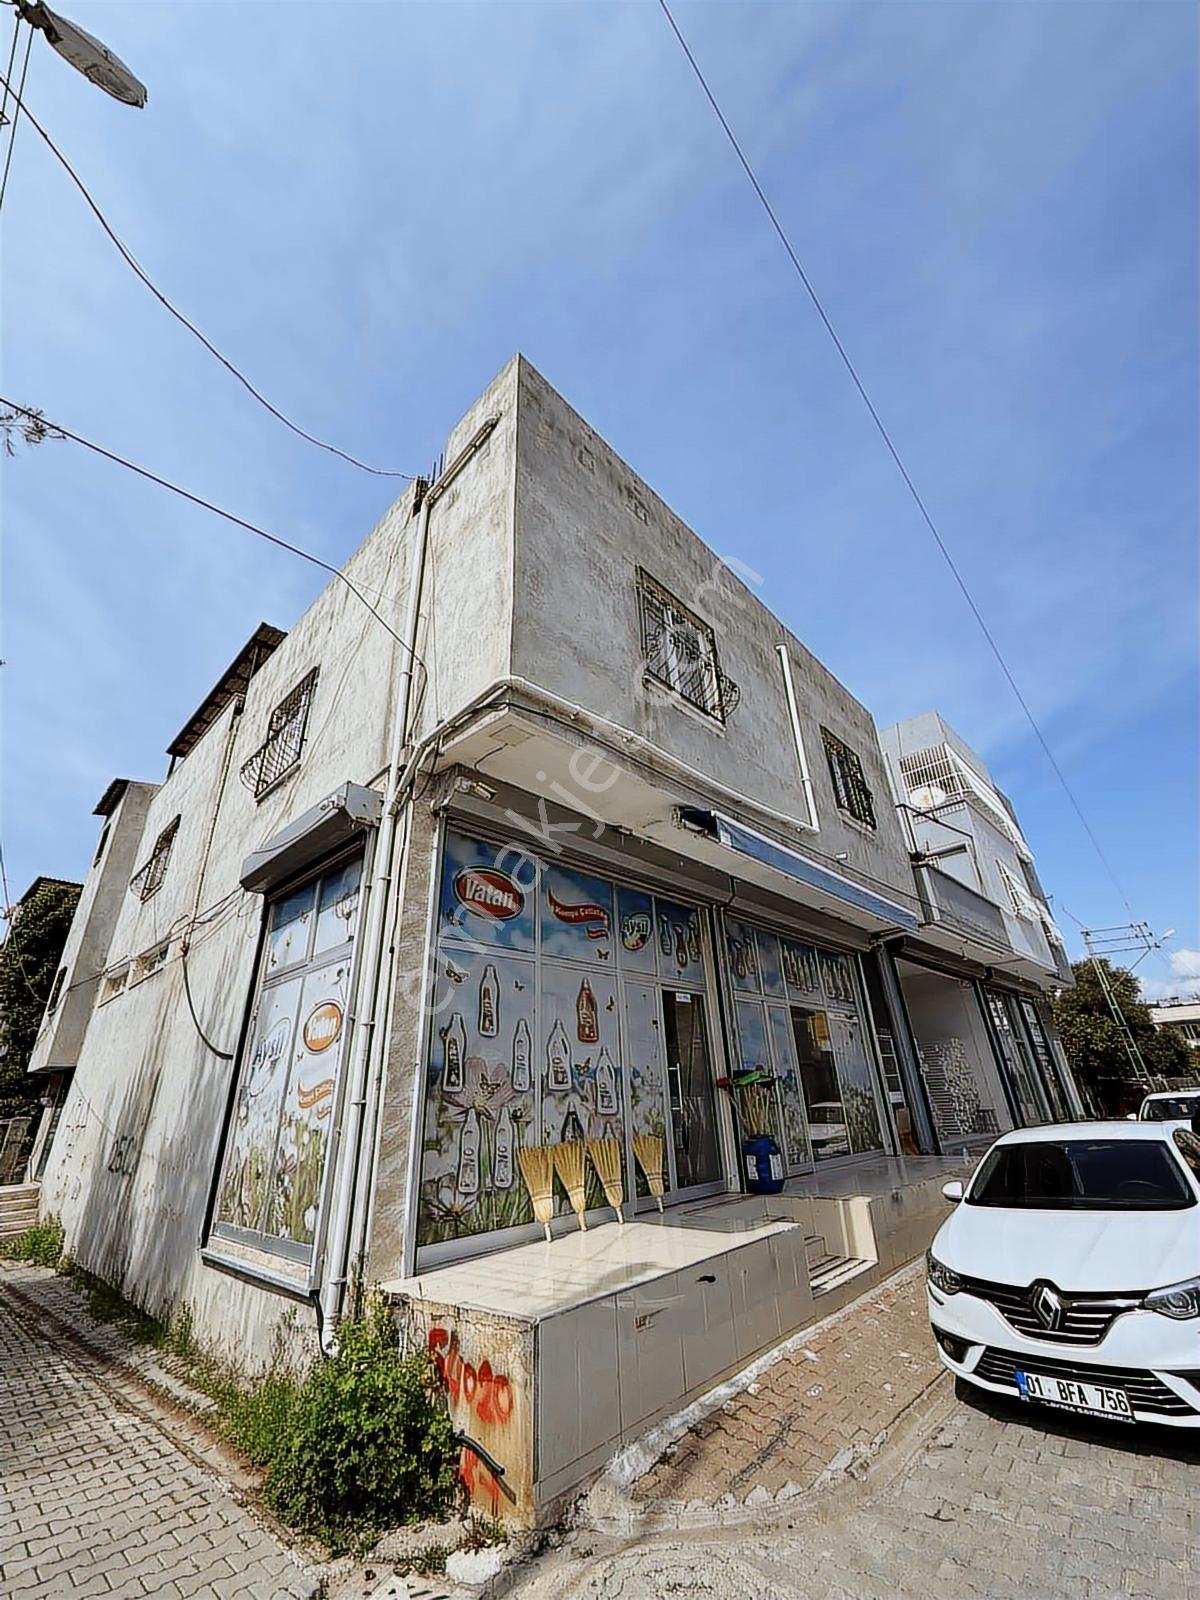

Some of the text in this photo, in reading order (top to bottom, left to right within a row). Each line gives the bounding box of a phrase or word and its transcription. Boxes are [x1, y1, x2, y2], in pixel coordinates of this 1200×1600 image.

[464, 878, 514, 909] Vatan
[1025, 1375, 1044, 1397] 01
[1056, 1381, 1089, 1406] BFA
[1094, 1387, 1128, 1413] 756
